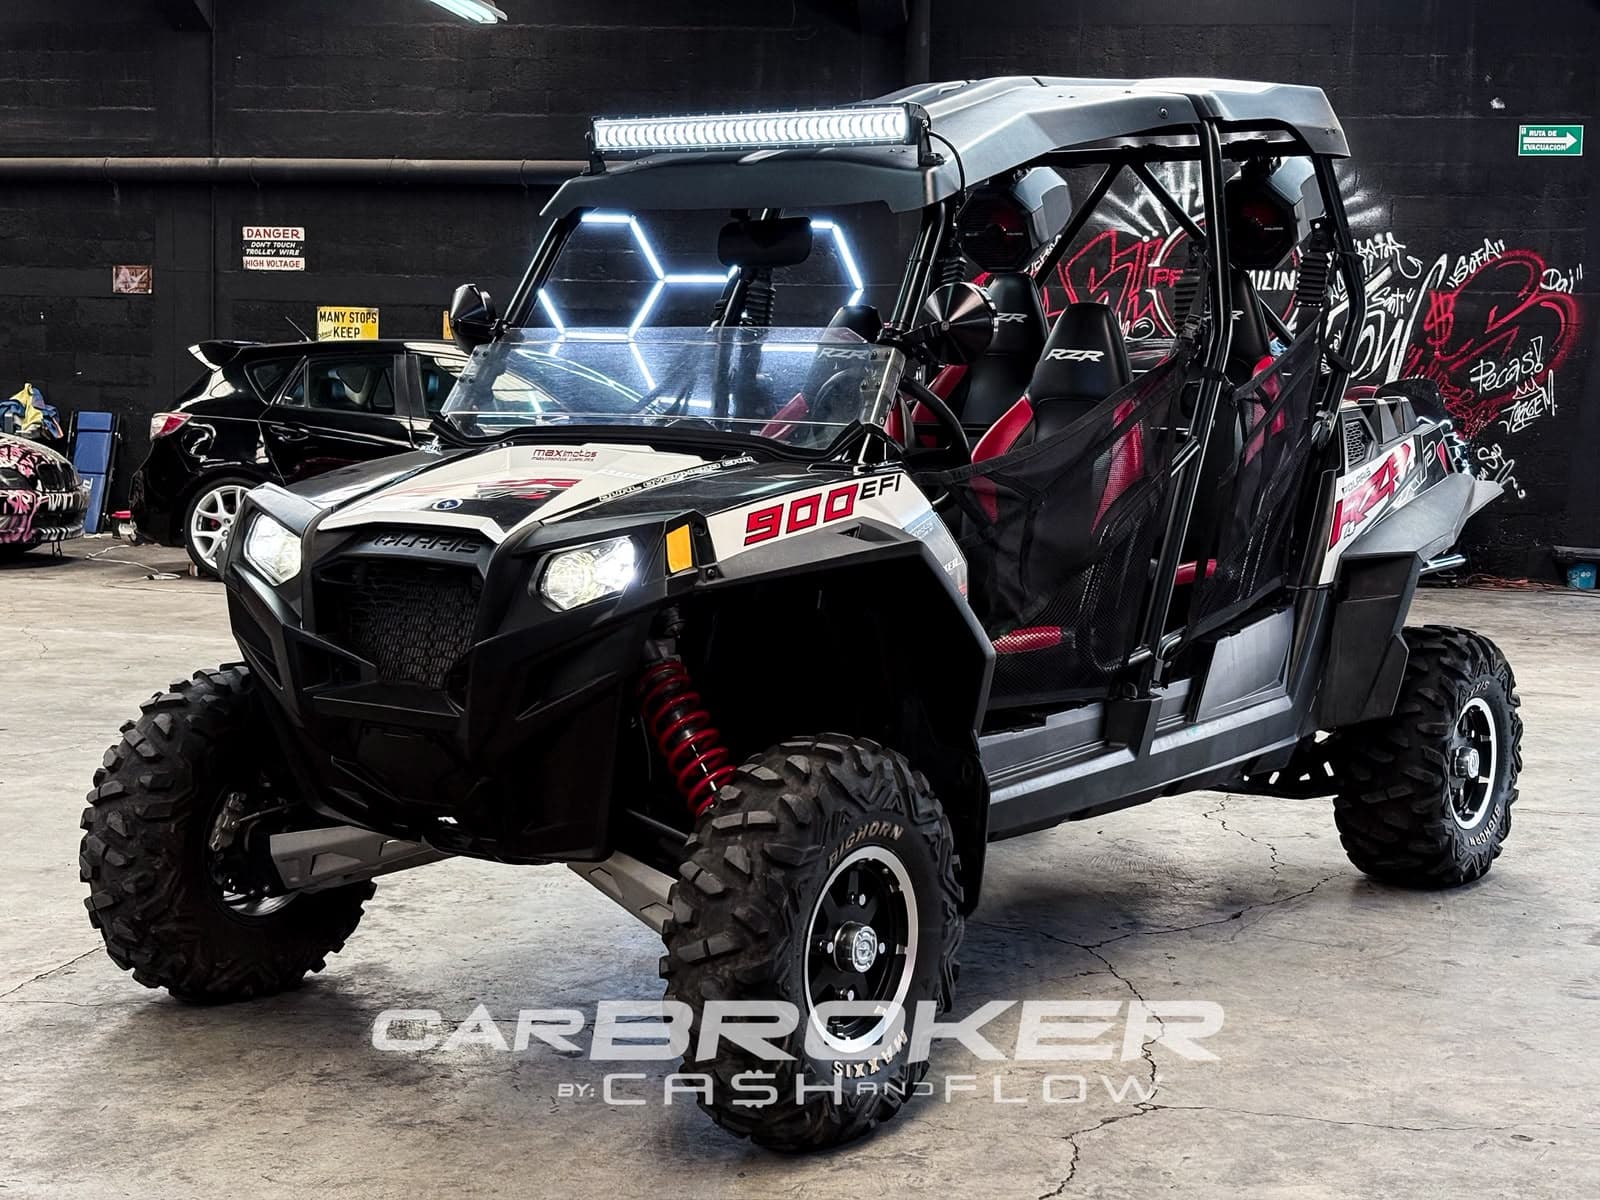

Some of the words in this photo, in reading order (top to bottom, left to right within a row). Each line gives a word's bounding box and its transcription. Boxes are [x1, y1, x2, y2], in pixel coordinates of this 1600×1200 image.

[246, 228, 300, 239] DANGER
[273, 241, 296, 249] TOUCH
[245, 260, 264, 268] HIGH
[266, 260, 301, 268] VOLTAGE
[320, 311, 346, 323] MANY
[349, 311, 377, 324] STOPS
[996, 312, 1028, 323] ZR
[333, 326, 361, 339] KEEP
[1045, 349, 1104, 362] RZR
[744, 483, 859, 546] 900
[859, 474, 901, 500] EFI
[1469, 803, 1501, 846] BIGHORN
[827, 820, 905, 872] BIGHORN
[832, 1029, 908, 1079] MAXXIS
